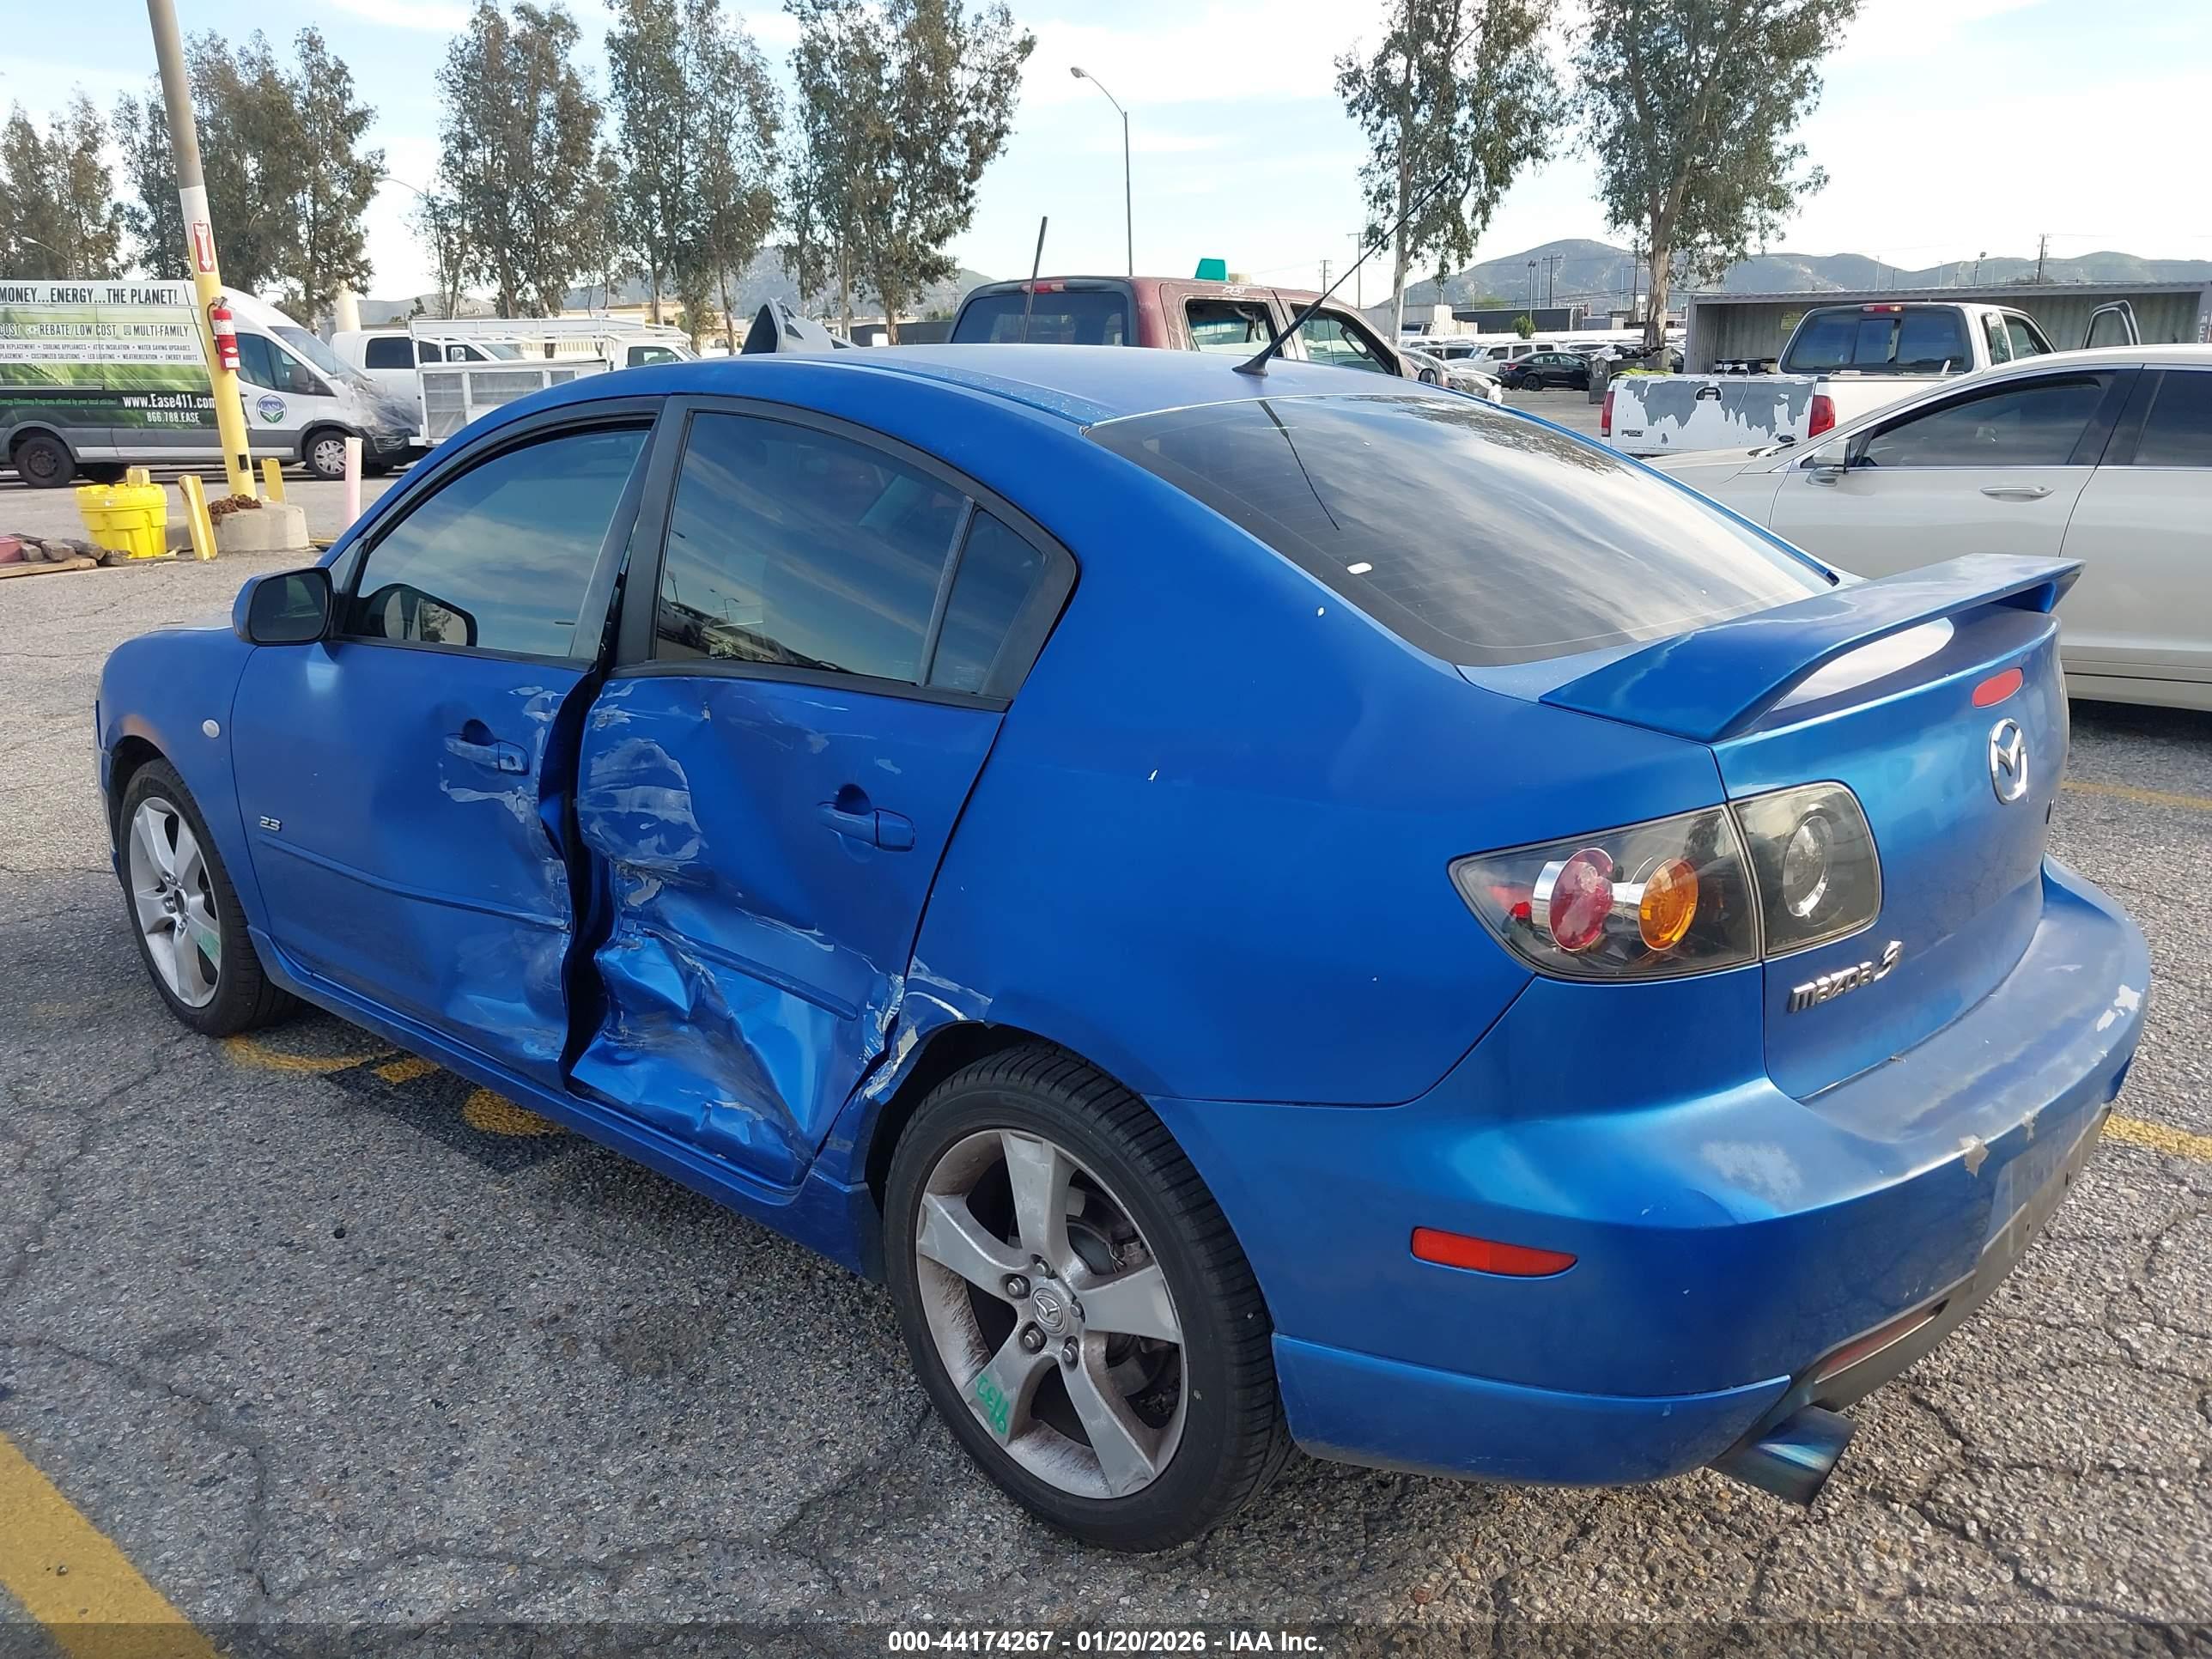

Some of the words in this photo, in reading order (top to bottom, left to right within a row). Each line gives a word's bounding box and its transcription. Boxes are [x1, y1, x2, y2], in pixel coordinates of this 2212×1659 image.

[131, 289, 178, 304] PLANET!
[0, 324, 19, 335] COST
[40, 324, 93, 335] REBATE/LOW
[95, 325, 117, 336] COST
[134, 325, 188, 337] MULTI-FAMILY
[147, 411, 199, 422] 866.788.EASE
